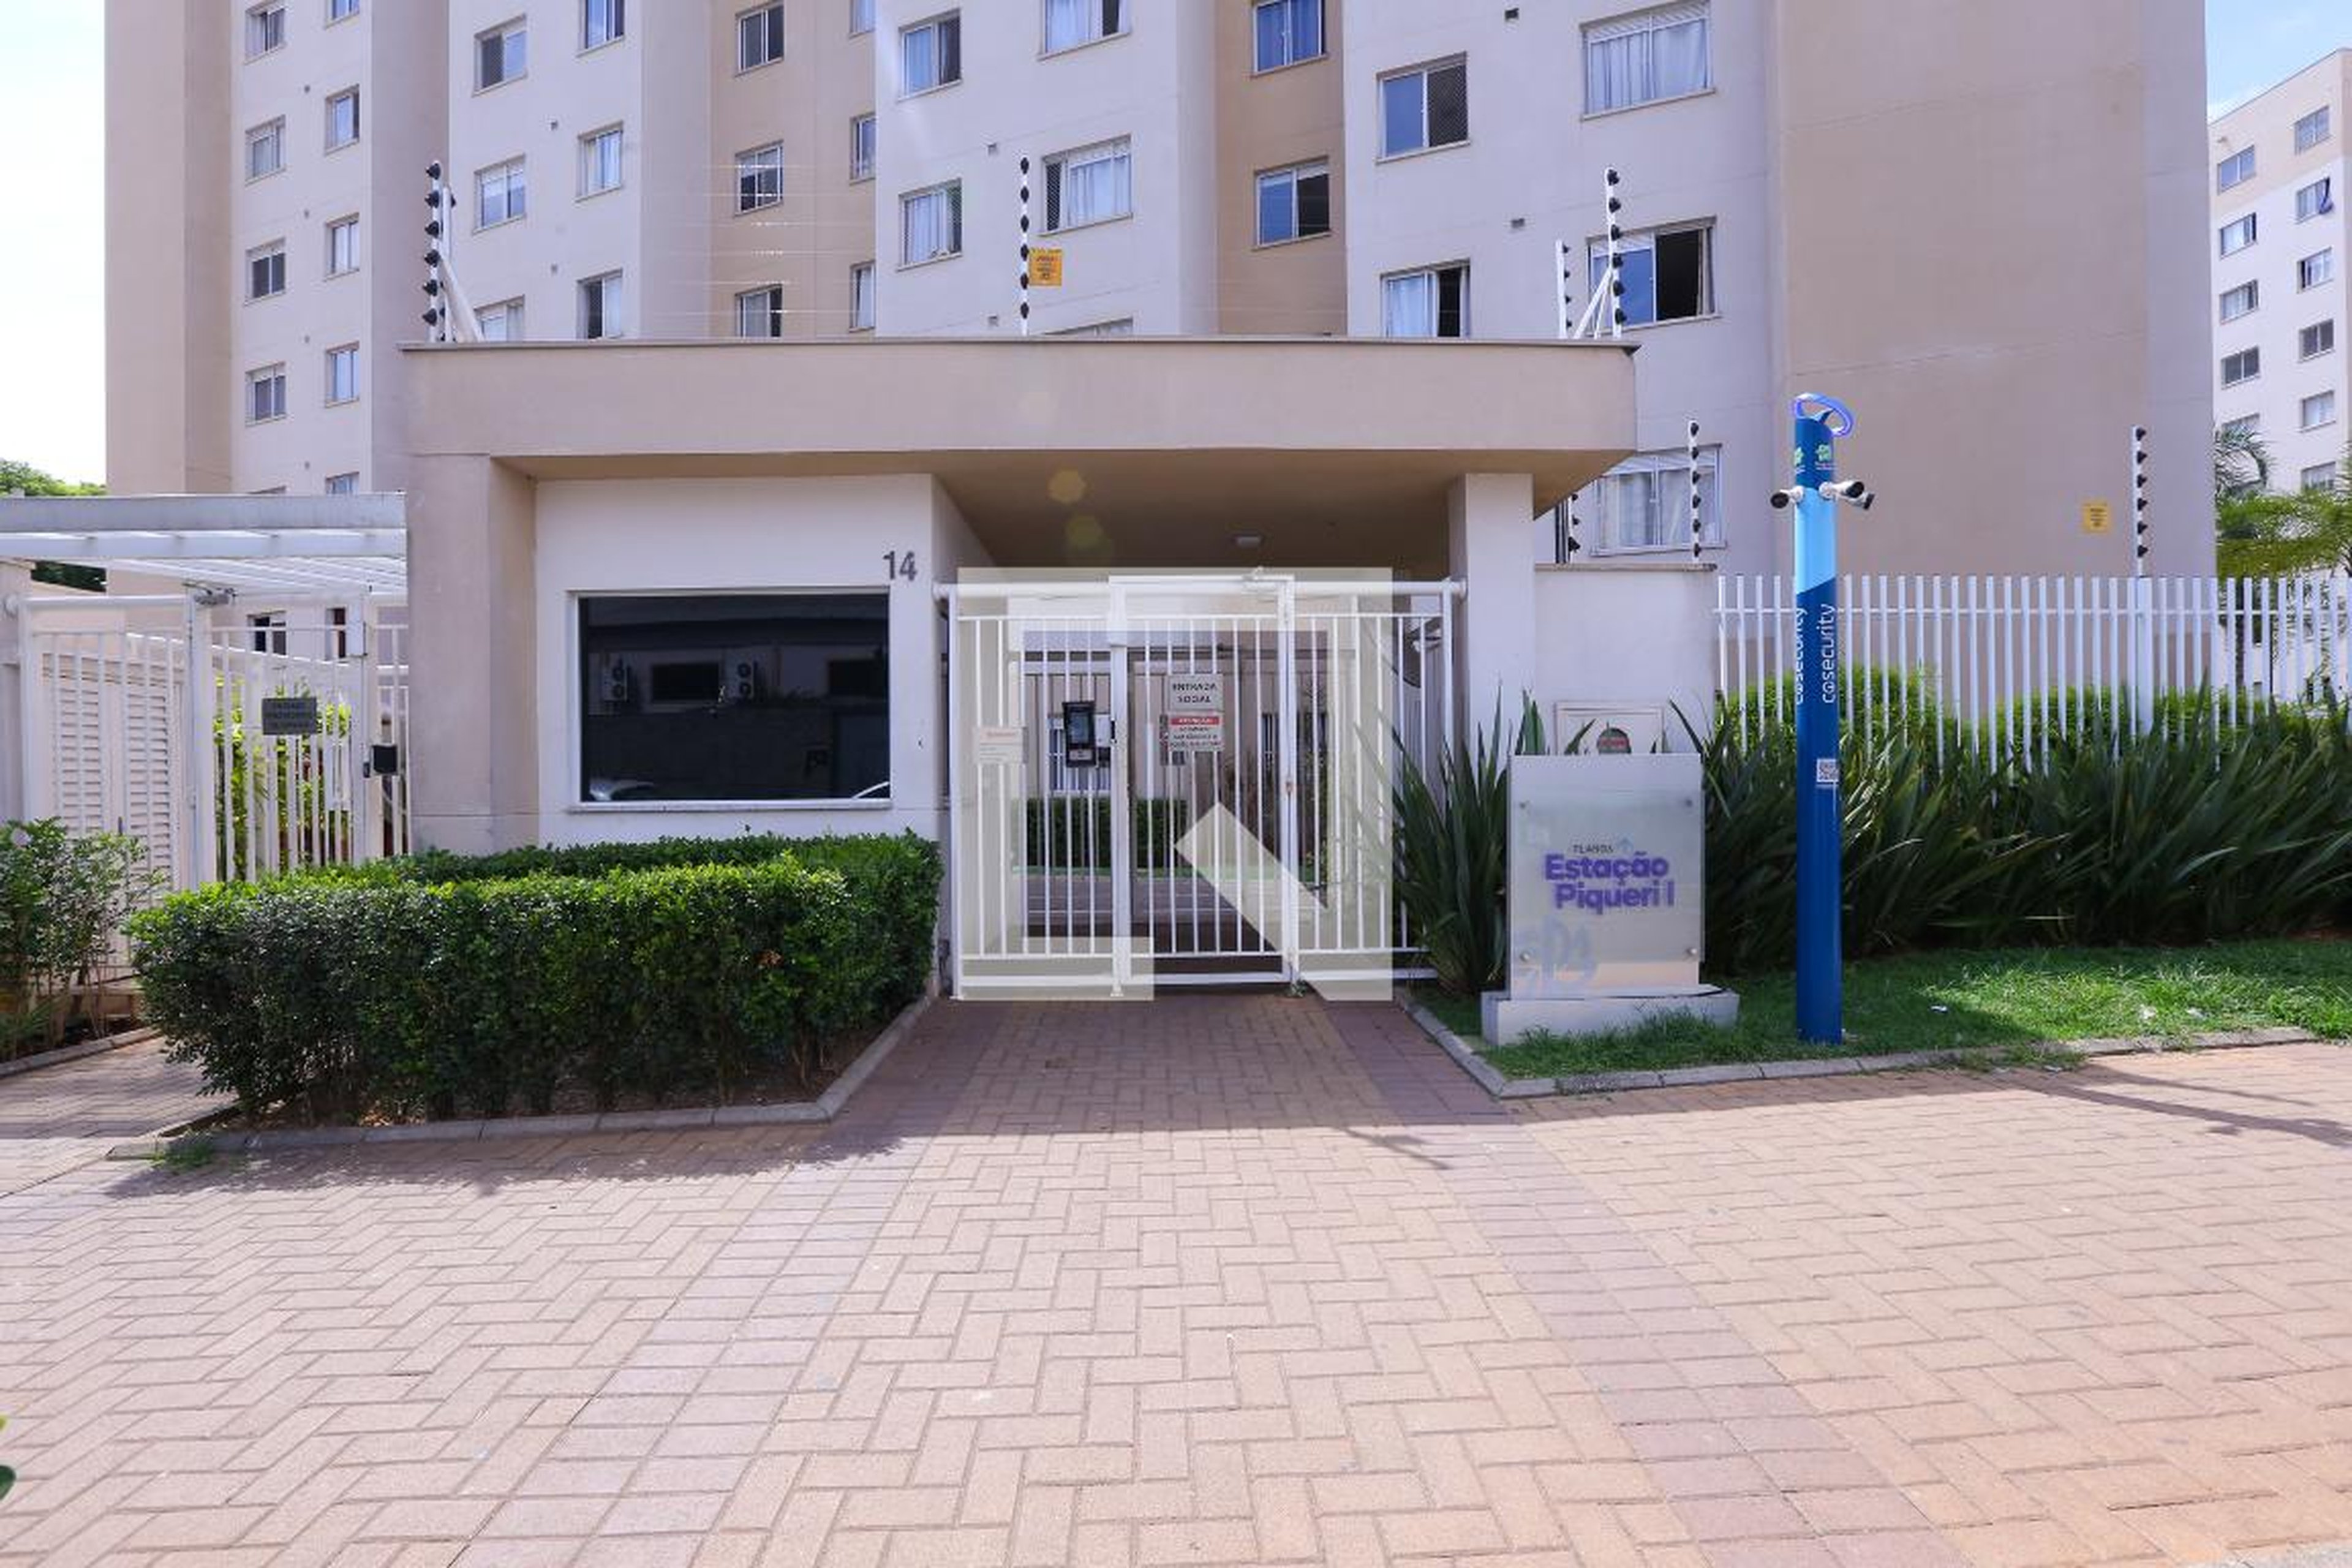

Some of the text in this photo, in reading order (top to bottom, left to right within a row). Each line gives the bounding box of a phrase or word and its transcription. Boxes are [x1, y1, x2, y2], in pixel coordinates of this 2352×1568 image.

[883, 550, 918, 581] 14
[1815, 603, 1836, 703] cosecurity
[1544, 851, 1669, 886] Estação
[1555, 880, 1660, 915] Piqueri
